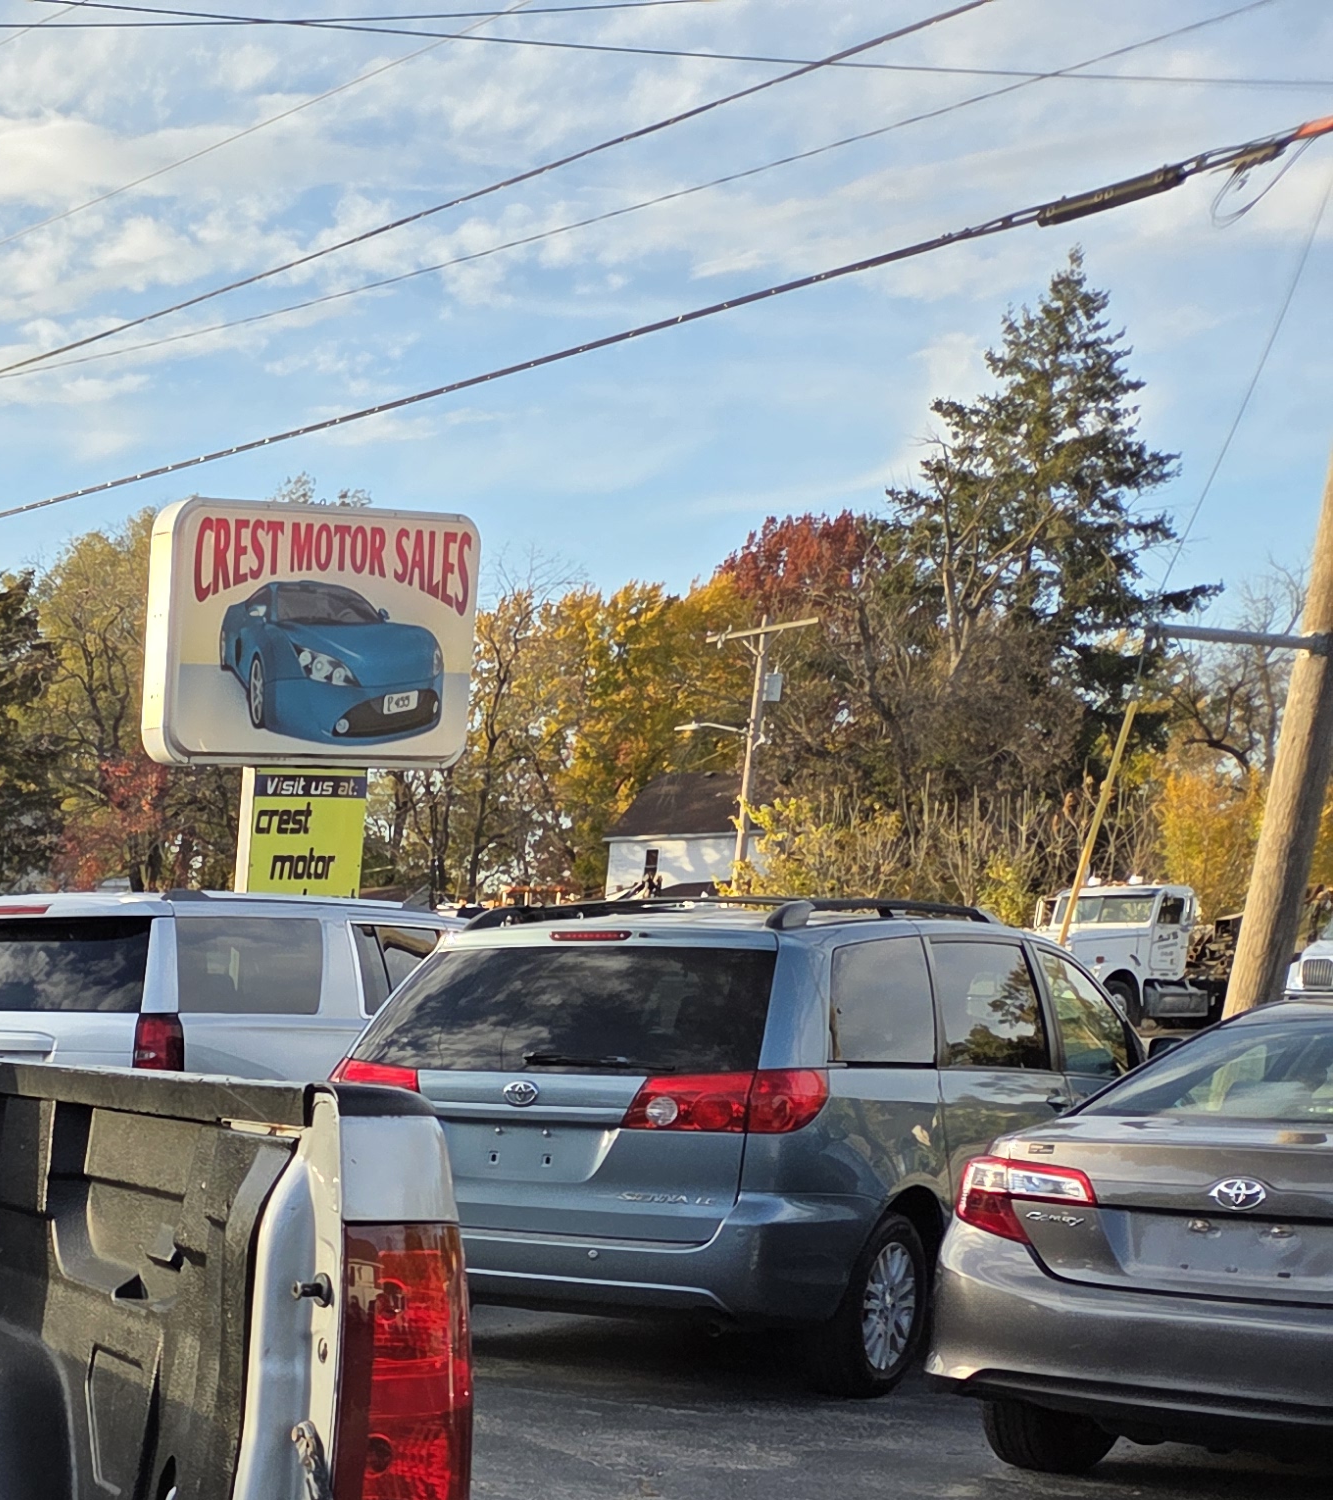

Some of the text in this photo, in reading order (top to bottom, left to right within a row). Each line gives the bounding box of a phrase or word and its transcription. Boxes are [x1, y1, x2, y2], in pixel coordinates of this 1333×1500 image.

[194, 516, 472, 617] CREST MOTOR SALES
[266, 776, 358, 796] Visit us at:
[254, 801, 313, 835] crest
[269, 847, 336, 881] motor
